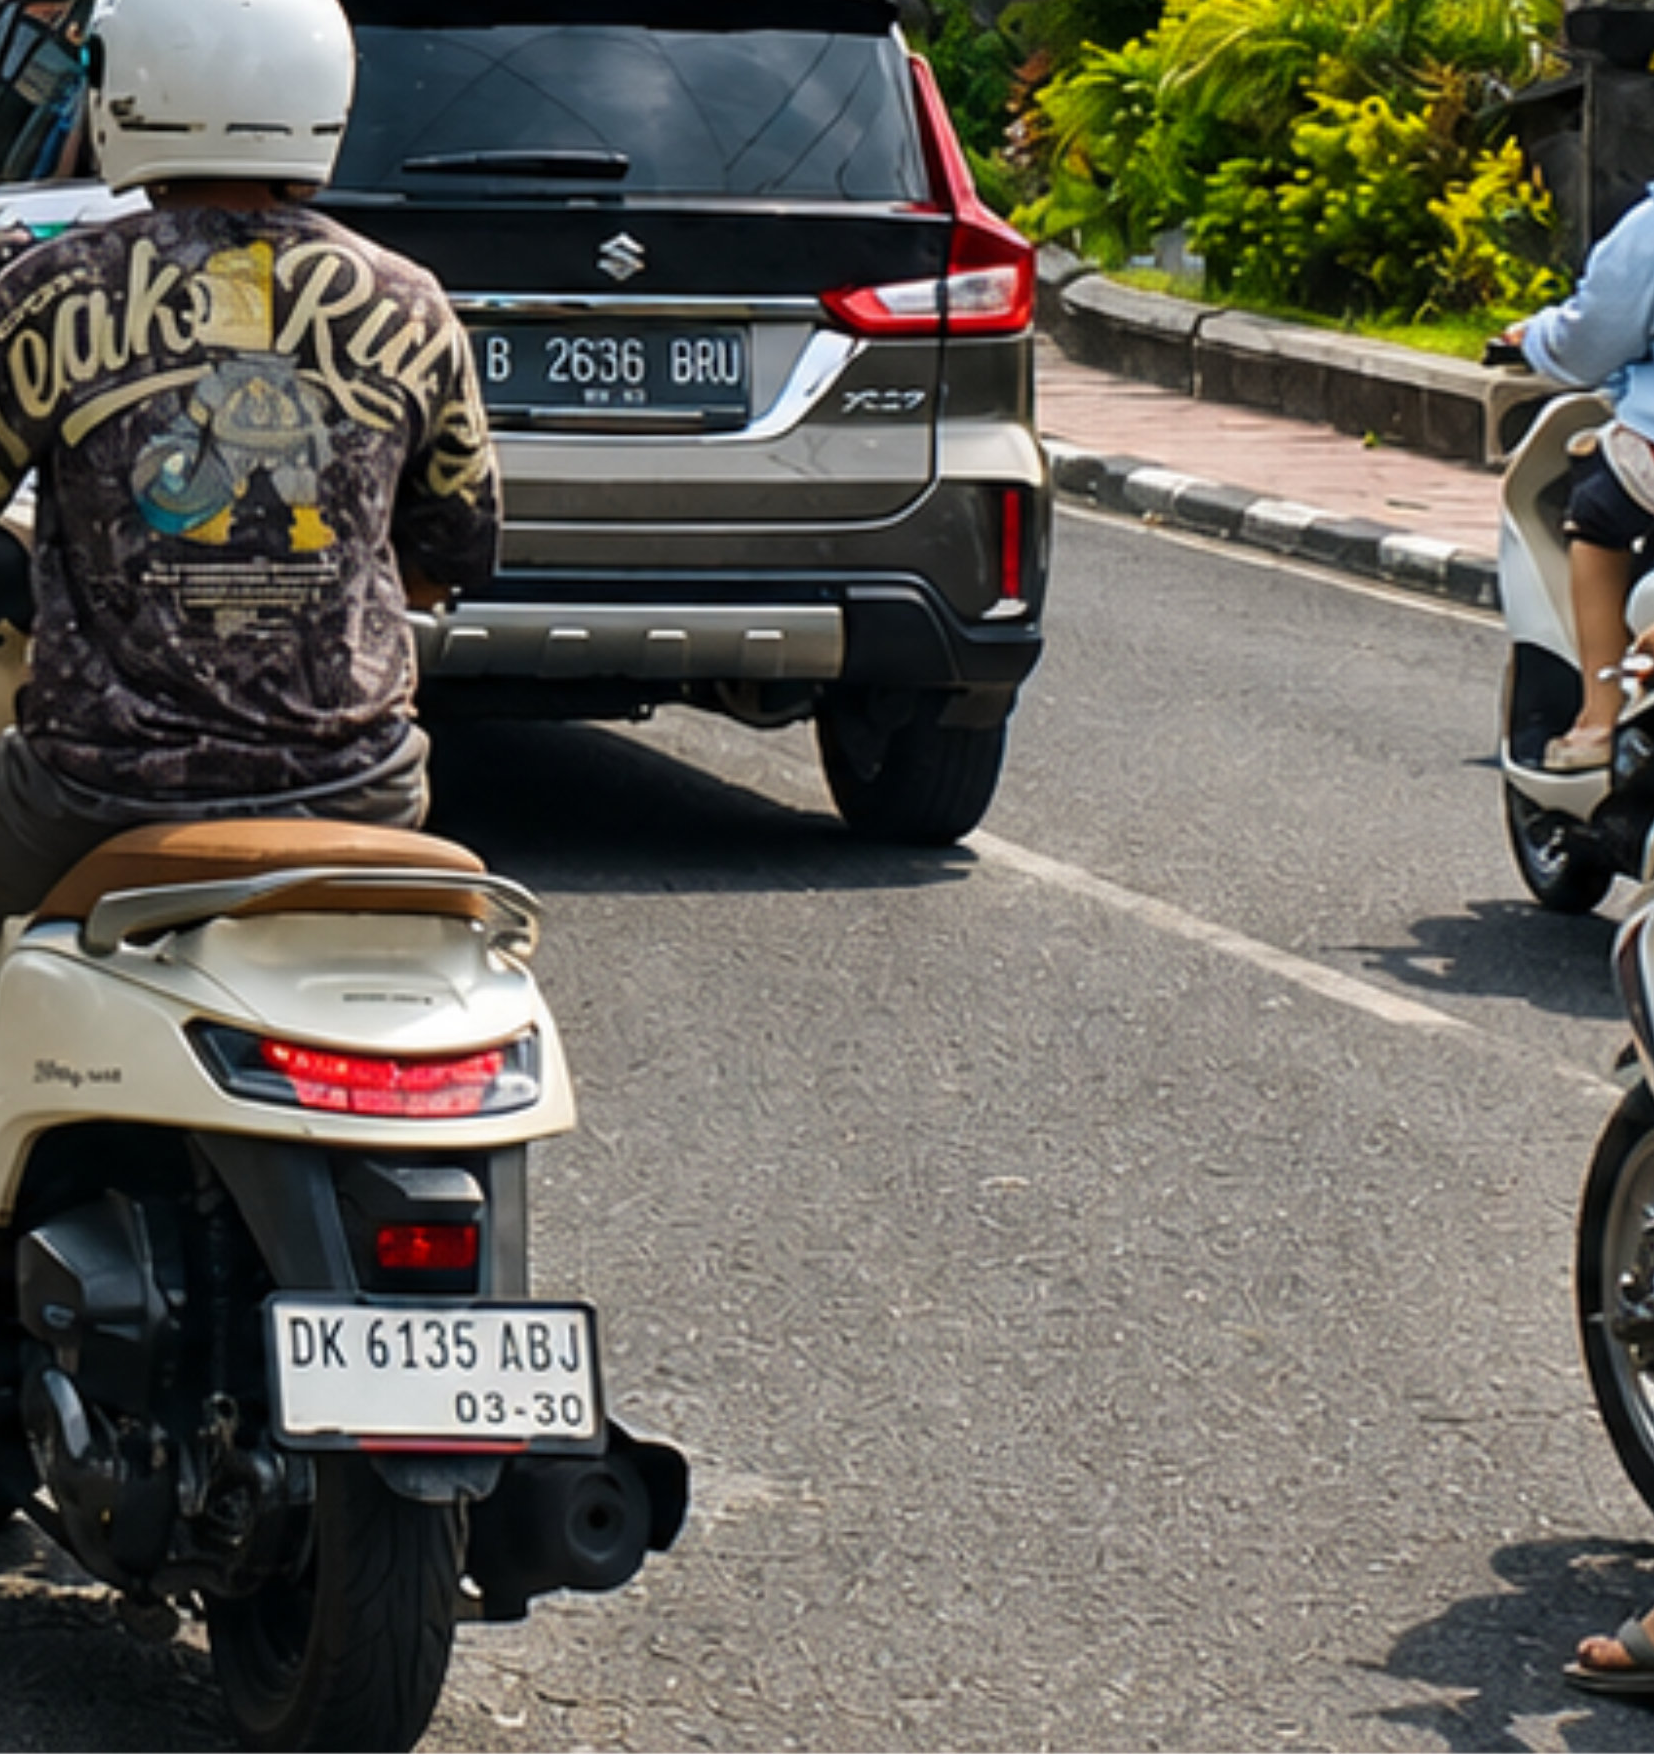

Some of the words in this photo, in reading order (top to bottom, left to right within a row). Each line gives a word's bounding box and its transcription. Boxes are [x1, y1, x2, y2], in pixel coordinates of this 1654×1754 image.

[486, 336, 511, 383] B
[545, 336, 645, 384] 2636
[669, 338, 740, 385] BRU
[289, 1316, 348, 1369] DK
[366, 1317, 478, 1370] 6135
[499, 1320, 581, 1374] ABJ
[454, 1390, 583, 1427] 03-30
